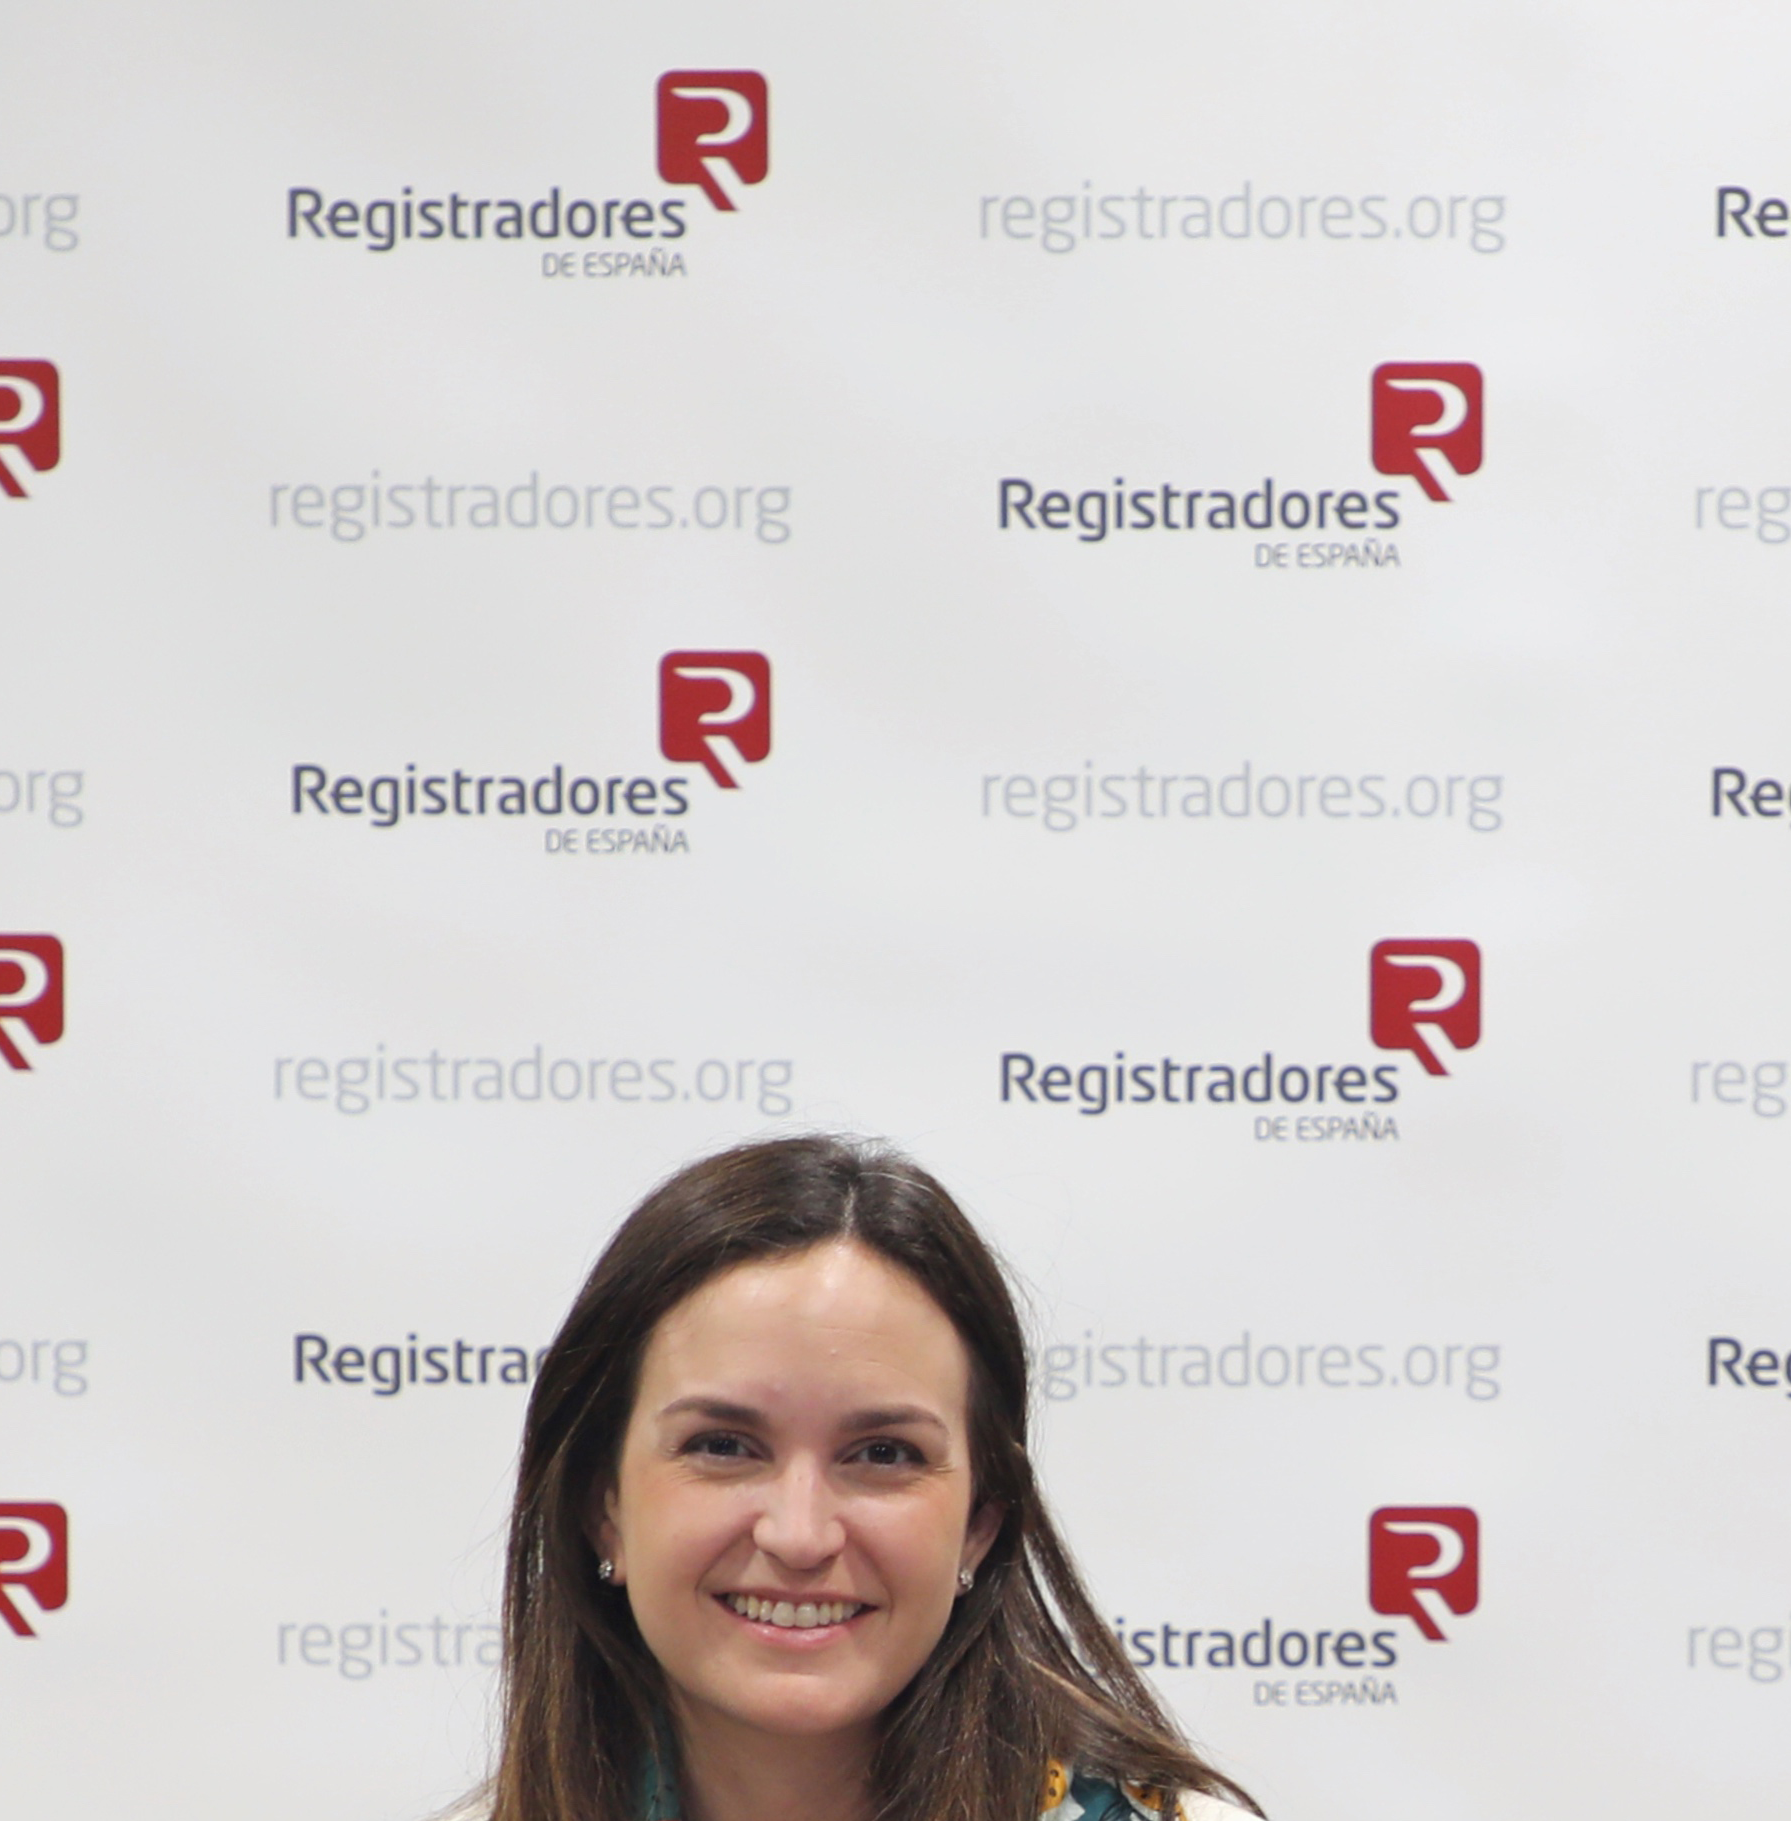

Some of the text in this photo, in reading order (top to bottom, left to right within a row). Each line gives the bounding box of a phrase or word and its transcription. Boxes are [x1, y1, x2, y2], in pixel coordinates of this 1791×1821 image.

[287, 185, 685, 251] Registradores
[978, 179, 1506, 257] registradores.org
[542, 247, 687, 279] DE ESPAÑA
[269, 469, 792, 546] registradores.org
[998, 476, 1401, 543] Registradores
[1254, 537, 1401, 569] DE ESPAÑA
[290, 762, 689, 827] Registradores
[982, 759, 1504, 833] registradores.org
[545, 824, 690, 855] DE ESPAÑA
[274, 1043, 793, 1117] registradores.org
[1001, 1050, 1399, 1116] Registradores
[1254, 1111, 1400, 1142] DE ESPAÑA
[294, 1332, 535, 1397] Registra
[1045, 1328, 1502, 1402] gistradores.org
[1113, 1618, 1398, 1670] istradores
[1254, 1676, 1398, 1706] DE ESPAÑA
